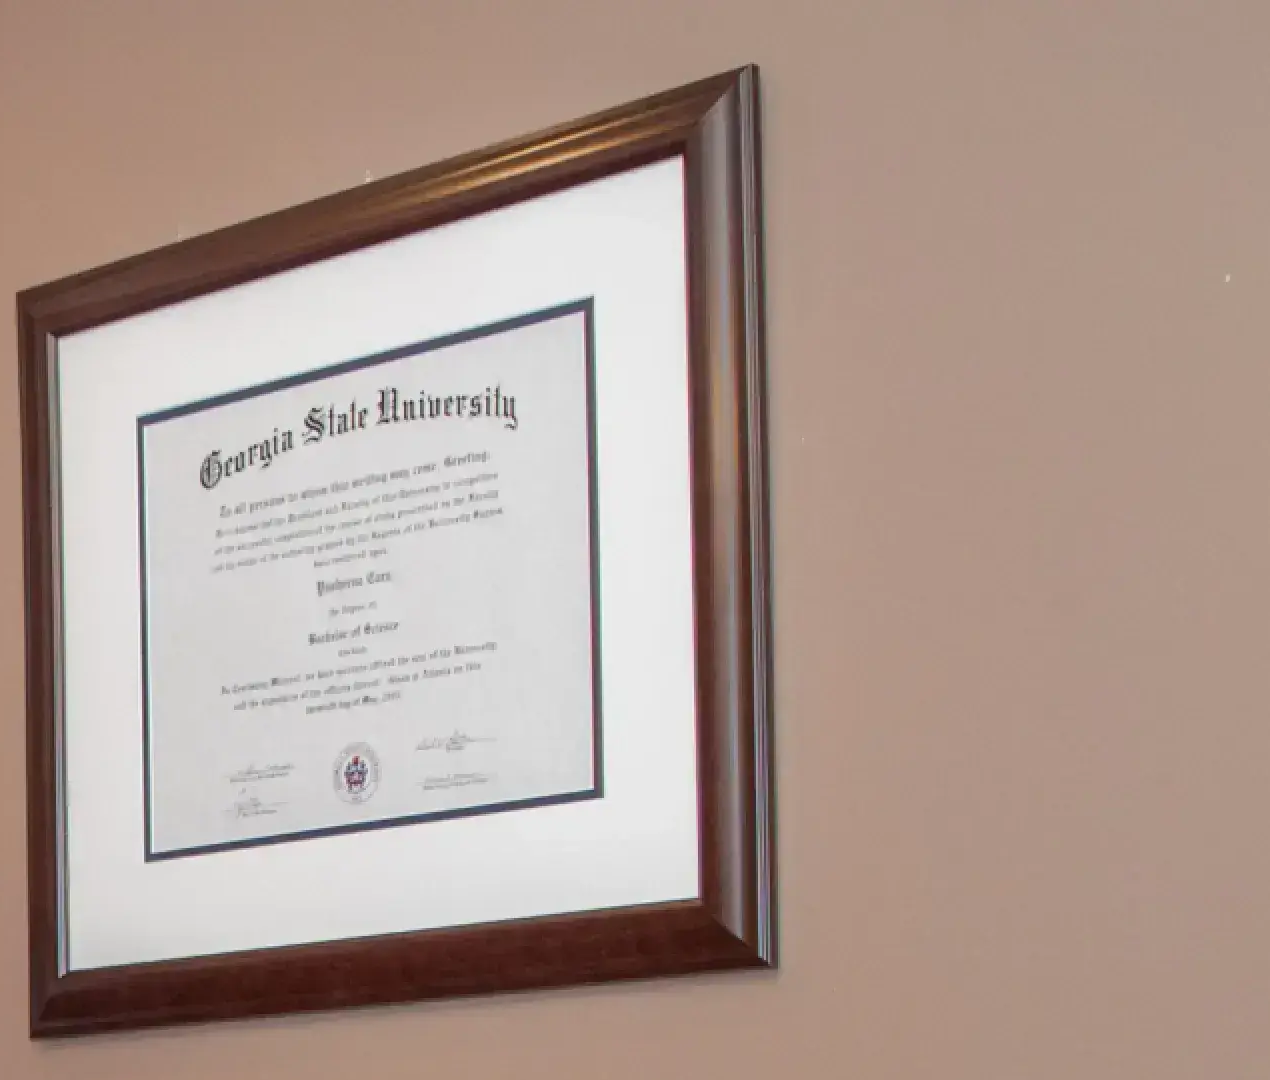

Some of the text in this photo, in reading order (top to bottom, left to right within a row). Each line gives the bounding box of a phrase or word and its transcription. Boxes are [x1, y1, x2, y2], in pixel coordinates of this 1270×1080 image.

[200, 380, 518, 489] Georgia State University
